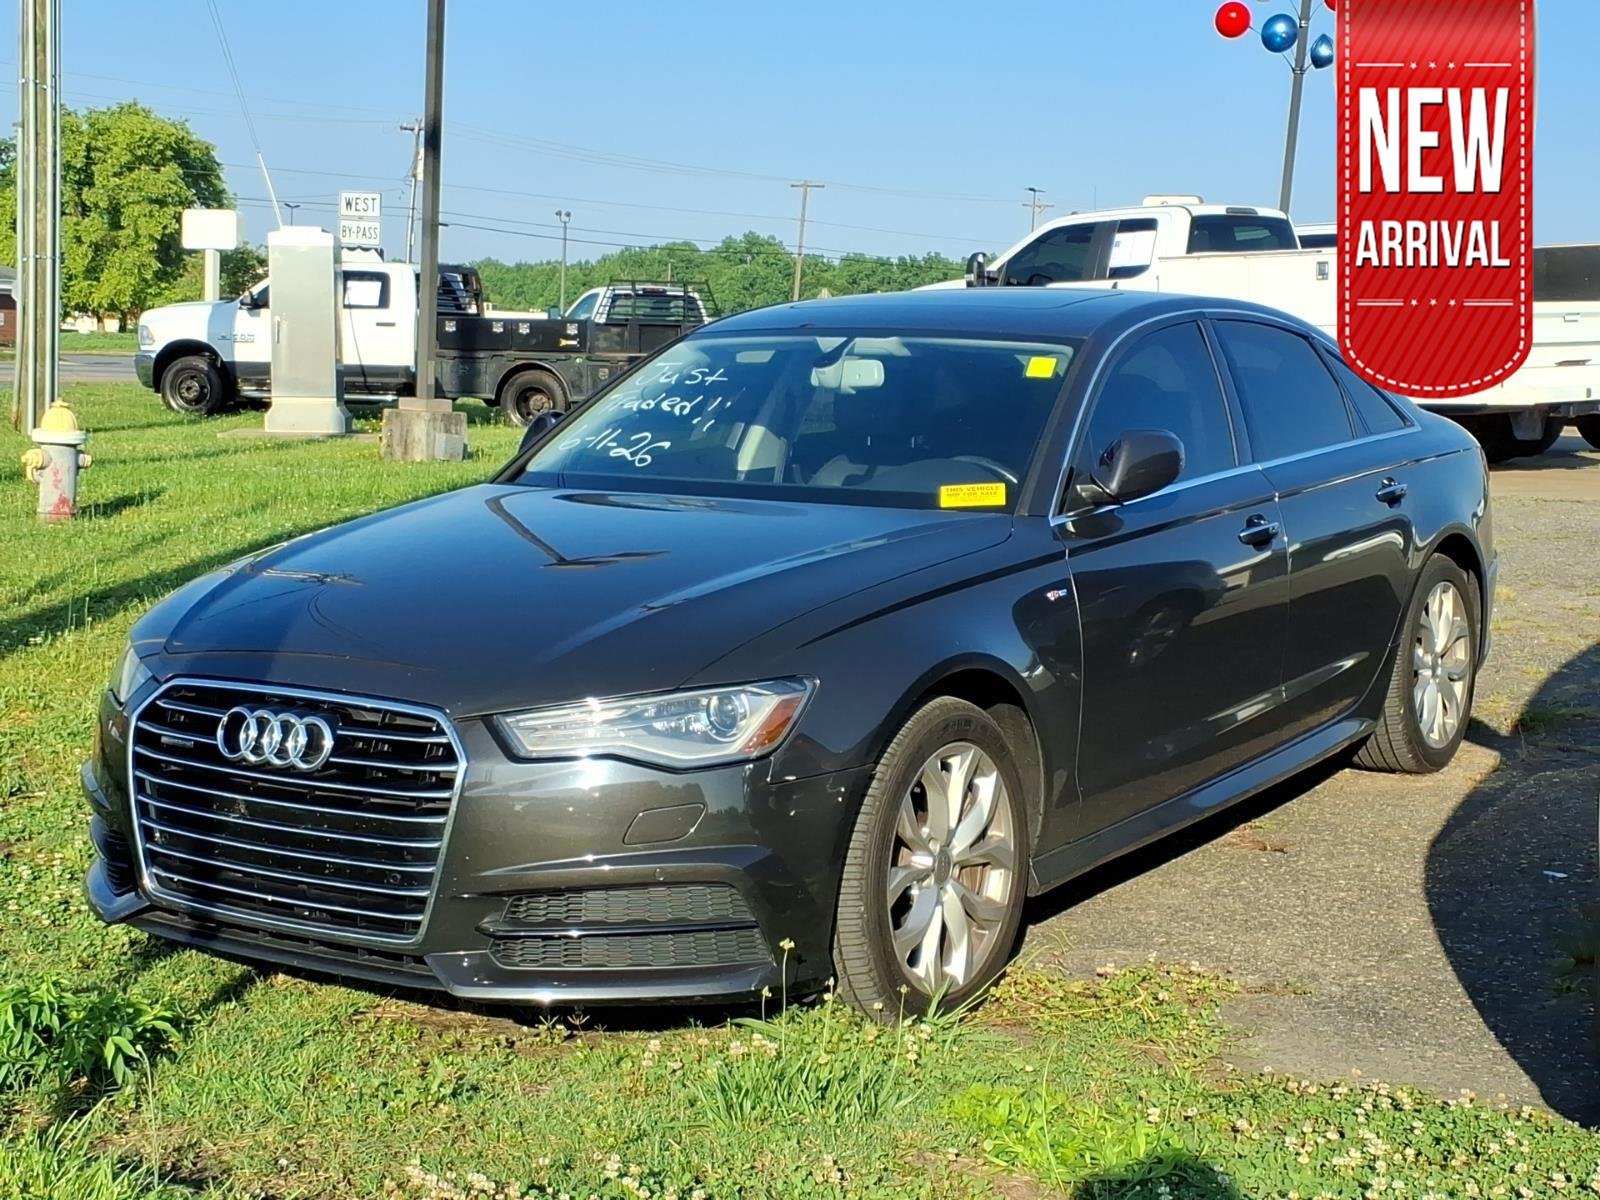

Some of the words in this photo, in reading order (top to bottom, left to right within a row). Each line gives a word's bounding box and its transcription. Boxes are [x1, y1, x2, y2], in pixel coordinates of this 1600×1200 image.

[344, 196, 377, 212] WEST
[341, 225, 378, 240] BY-PASS
[634, 362, 729, 386] Just
